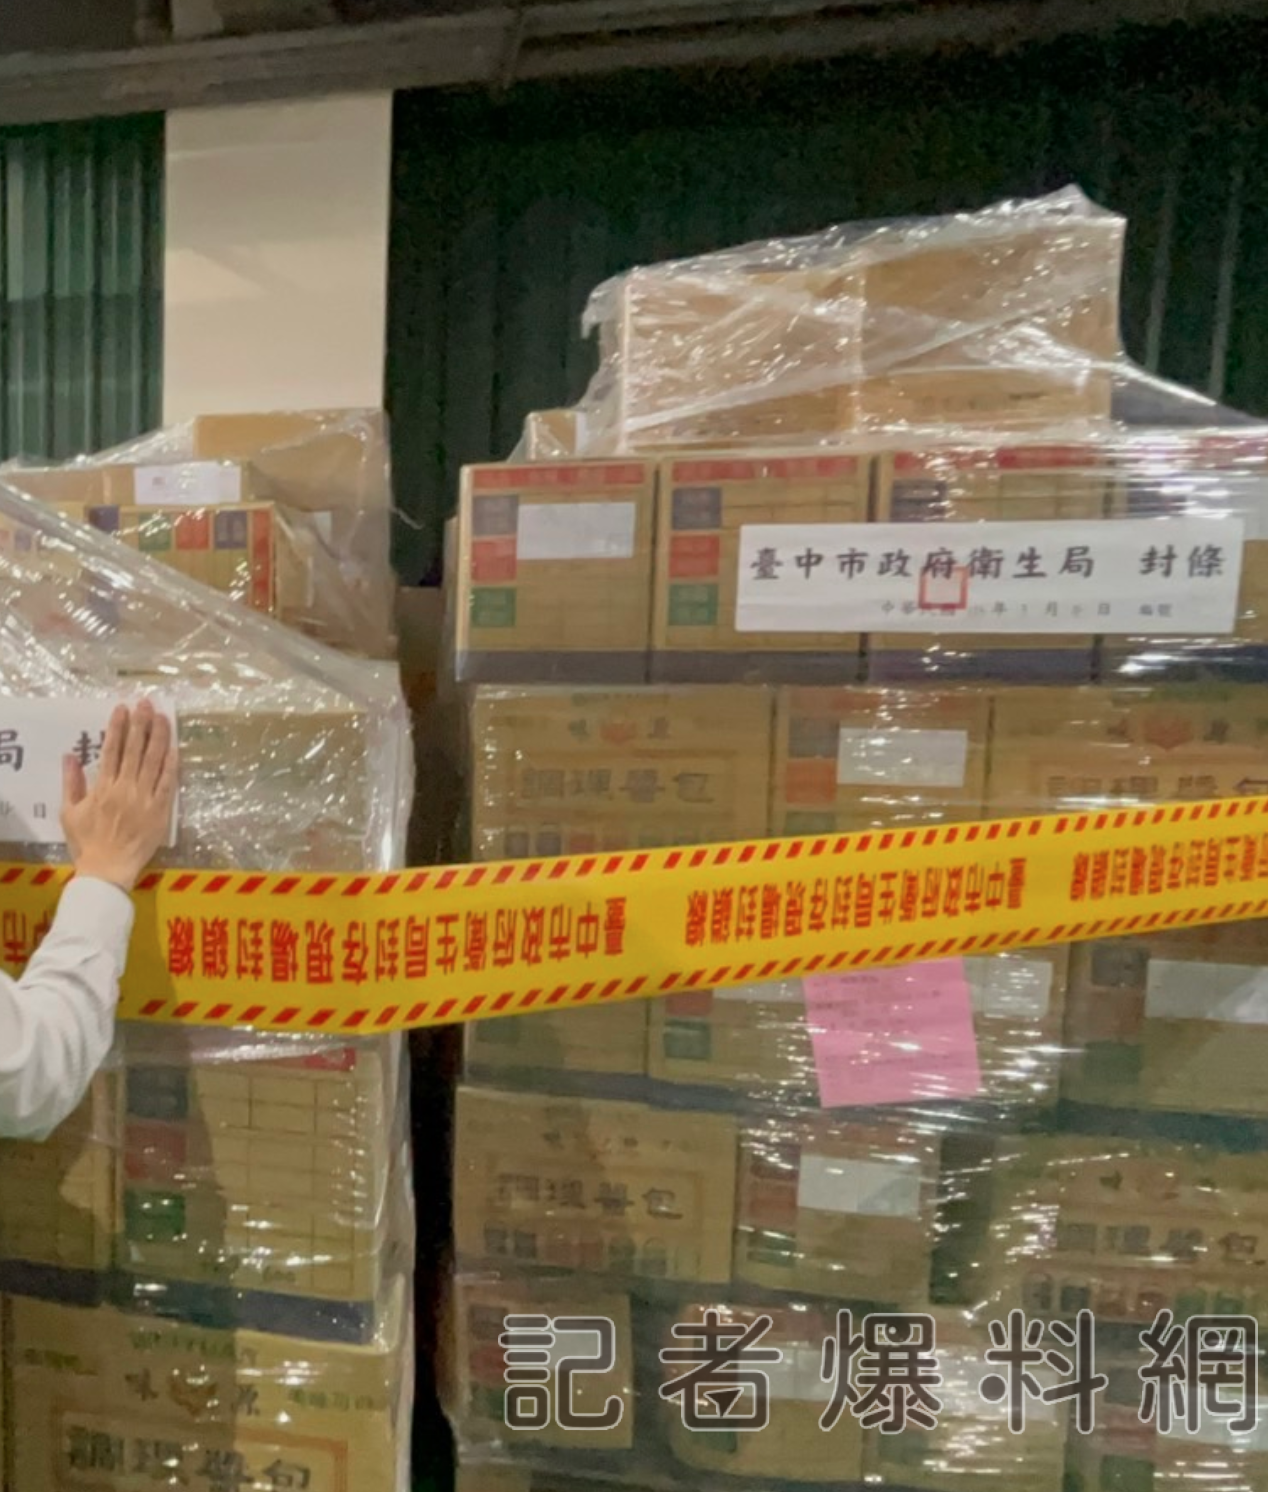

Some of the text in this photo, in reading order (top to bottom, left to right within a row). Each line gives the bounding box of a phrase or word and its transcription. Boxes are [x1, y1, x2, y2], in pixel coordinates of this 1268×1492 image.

[750, 544, 1227, 582] 臺中市政府衛生局 封條
[167, 896, 627, 985] 臺中市政府衛生局封存現場封鎖線
[685, 857, 1027, 948] 臺中市政府衛生局封存現場封鎖線
